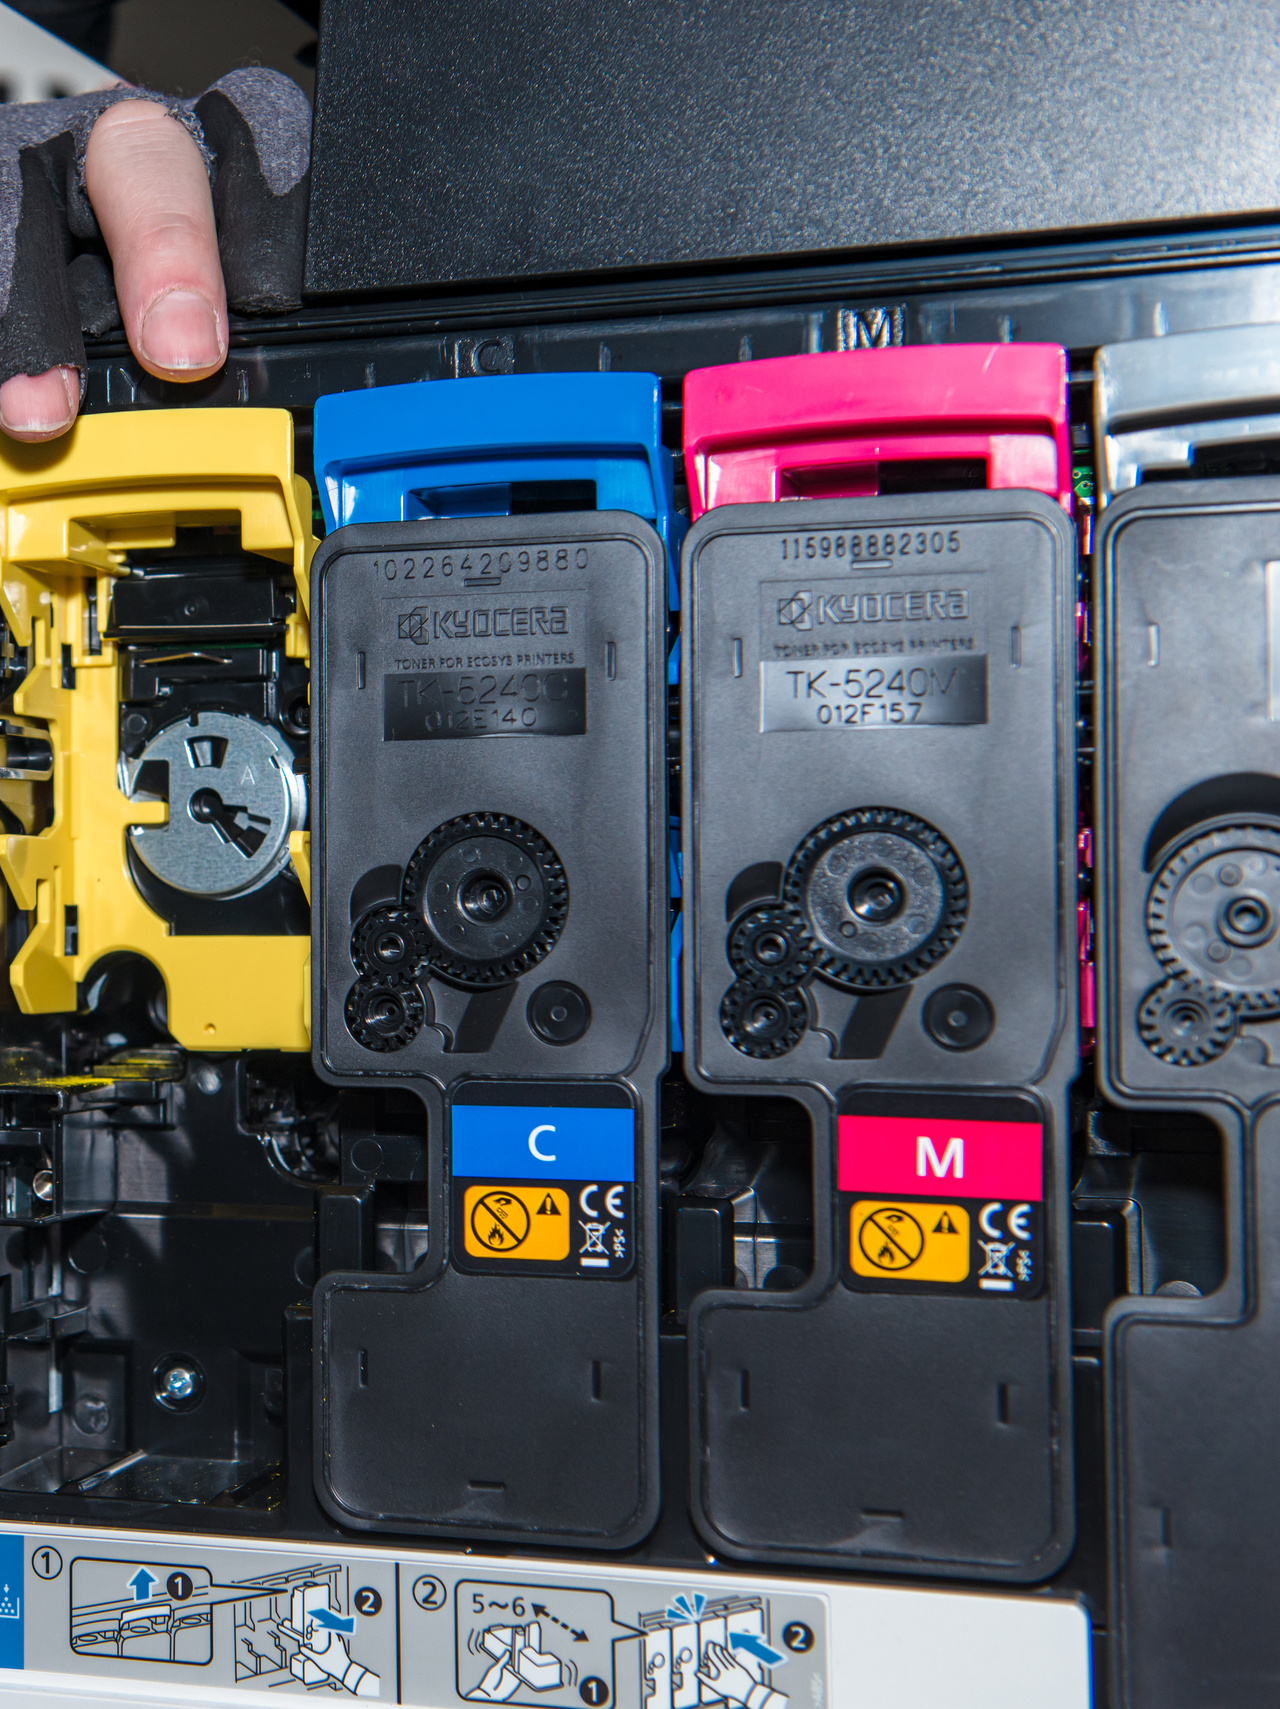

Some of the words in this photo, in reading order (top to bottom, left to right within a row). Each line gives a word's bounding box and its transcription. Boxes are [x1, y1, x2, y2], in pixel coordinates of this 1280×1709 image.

[855, 307, 895, 349] M
[471, 339, 504, 376] C
[781, 529, 962, 561] 115988882305
[373, 547, 590, 581] 102264209880
[433, 606, 569, 640] KYOCERA
[818, 588, 970, 625] KYOCERA
[395, 658, 436, 671] TONER
[439, 656, 463, 669] FOR
[467, 654, 513, 668] ECOSYS
[517, 652, 575, 666] PRINTERS
[395, 672, 569, 709] TK-5240C
[786, 667, 960, 699] TK-5240M
[424, 706, 538, 732] 012E140
[817, 702, 923, 725] 012F157
[240, 765, 256, 785] A
[528, 1124, 557, 1162] C
[916, 1136, 965, 1179] M
